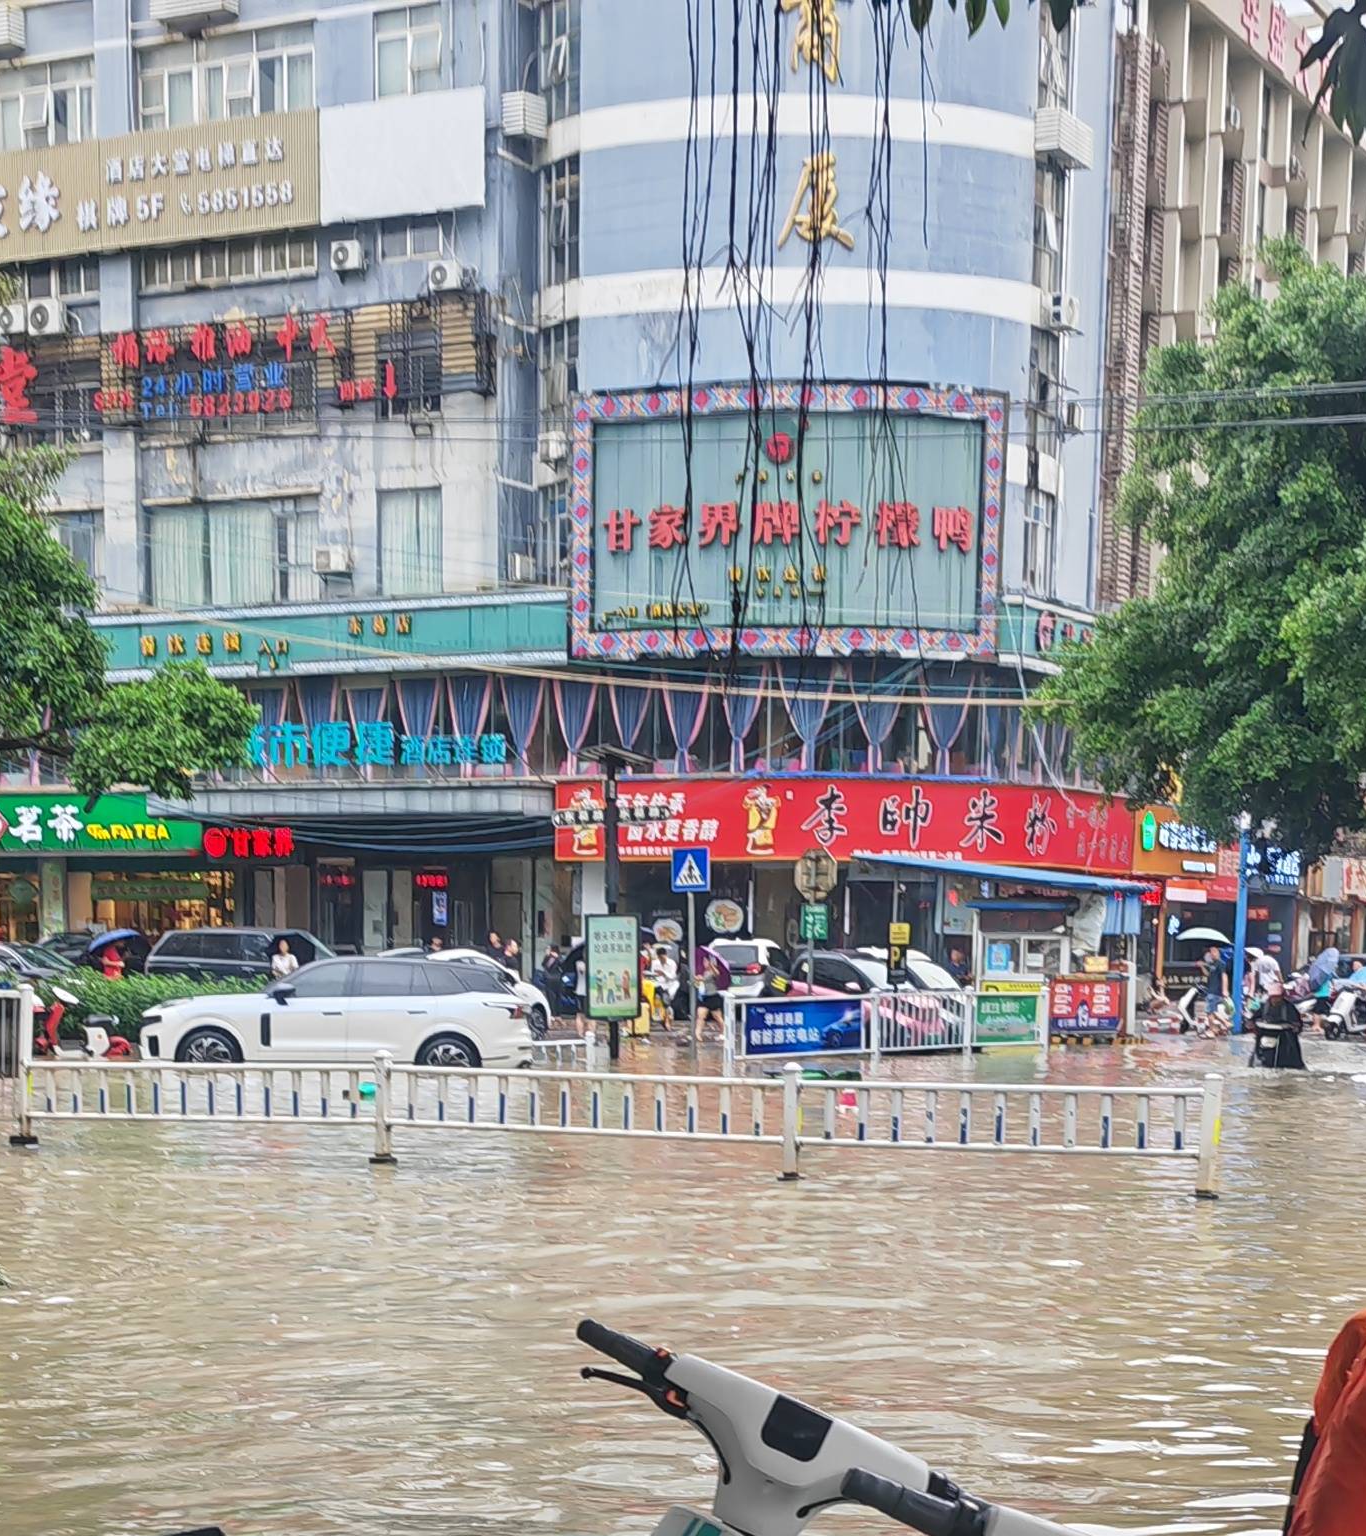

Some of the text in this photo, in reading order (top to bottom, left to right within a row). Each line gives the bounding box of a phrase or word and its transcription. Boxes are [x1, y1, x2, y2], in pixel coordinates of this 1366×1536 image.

[106, 136, 285, 185] 酒店大堂电梯直达
[135, 193, 166, 222] 5F
[141, 361, 284, 398] 24小时营业
[602, 499, 976, 555] 甘家界牌柠檬鸭
[400, 733, 507, 765] 酒店连锁
